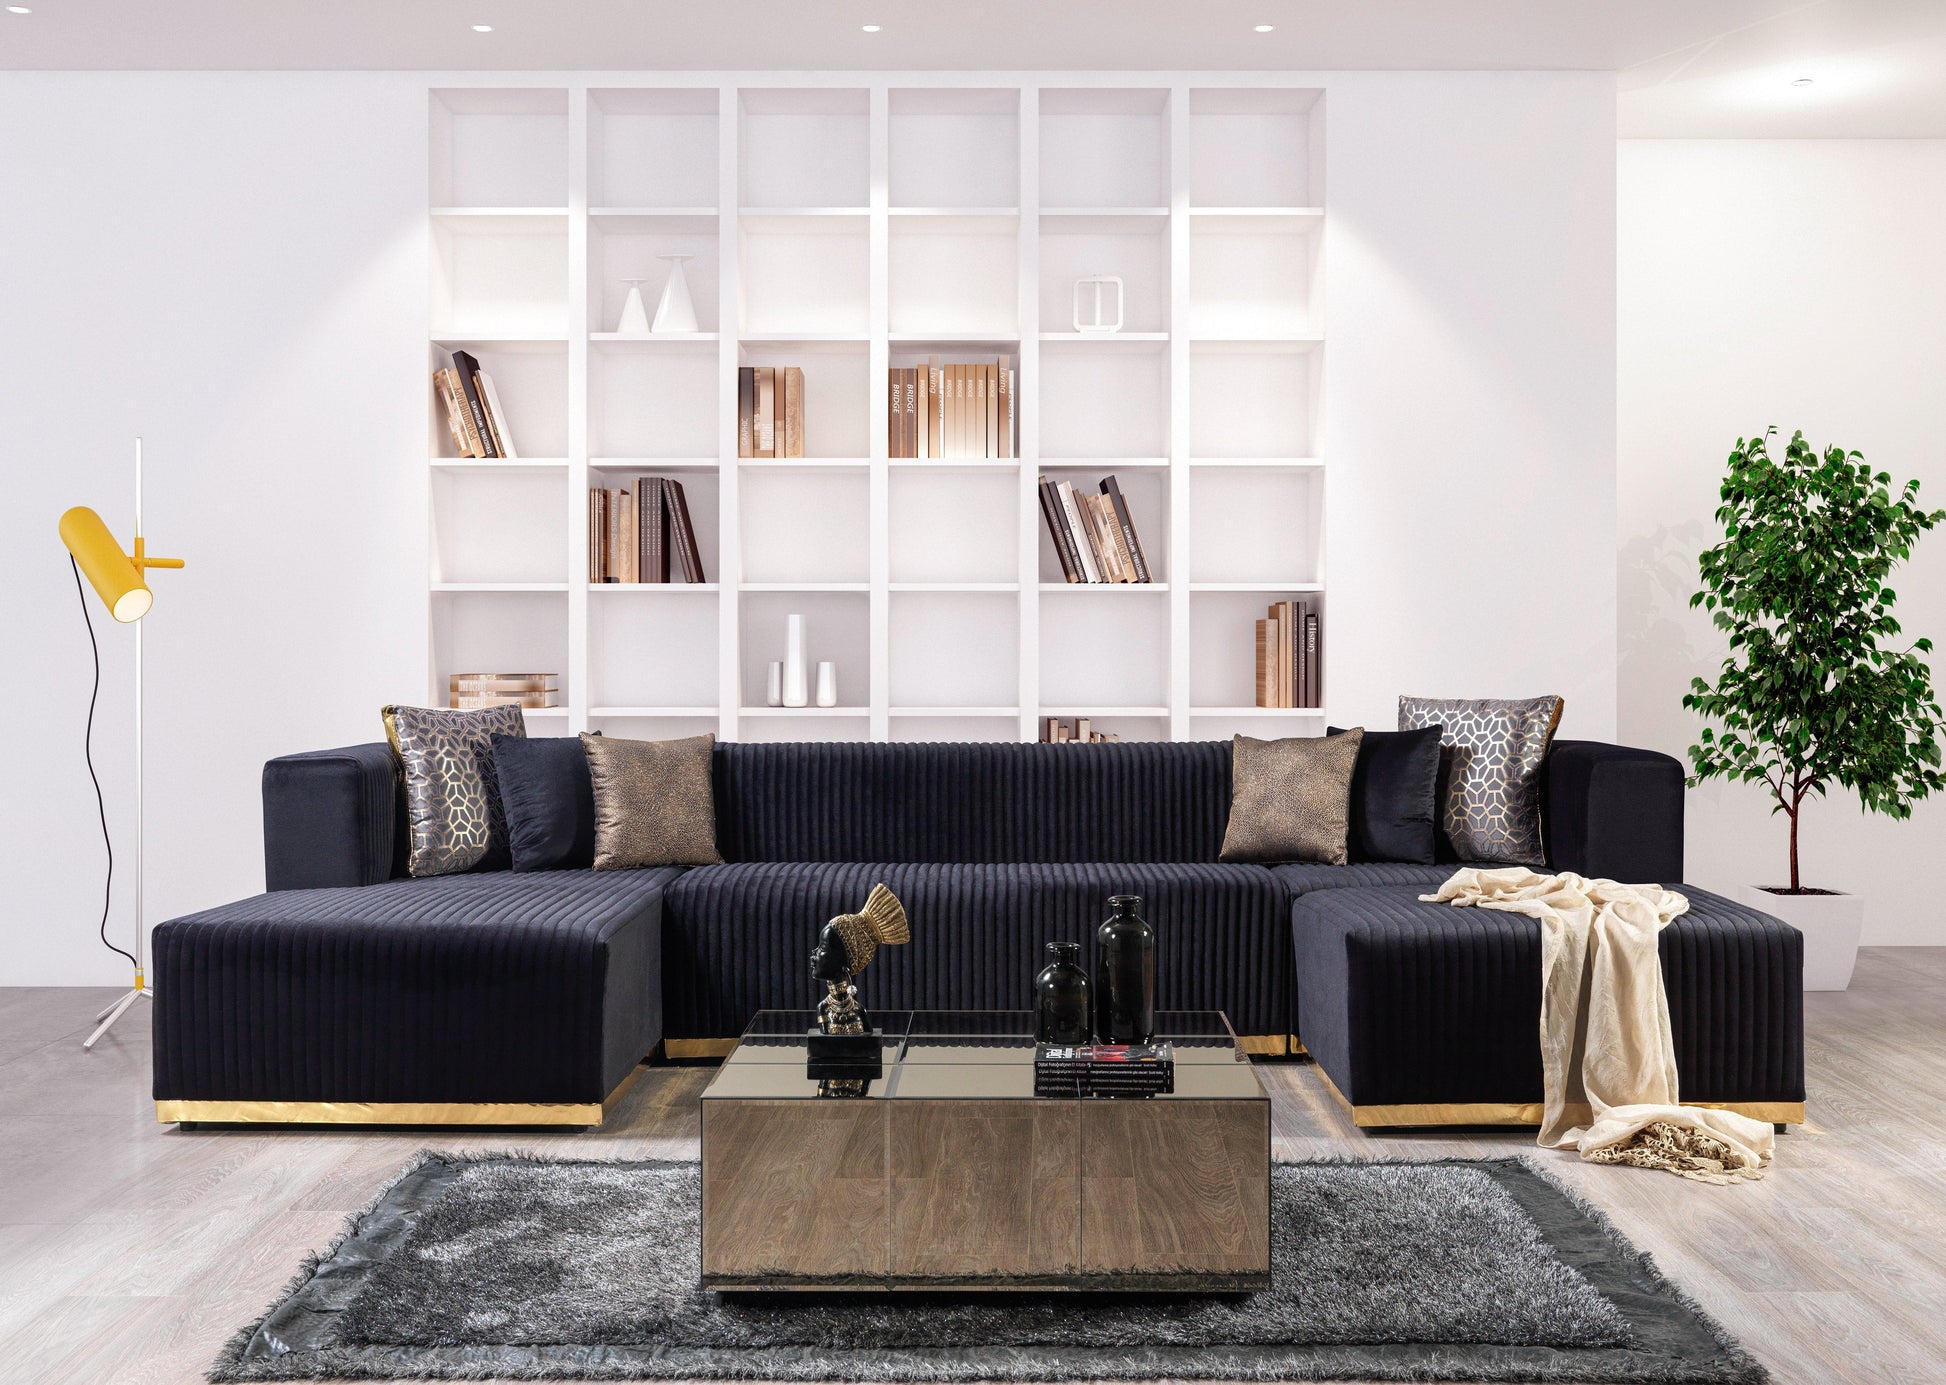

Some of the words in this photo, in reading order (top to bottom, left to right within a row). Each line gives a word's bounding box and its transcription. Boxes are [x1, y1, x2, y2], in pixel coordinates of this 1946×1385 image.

[929, 367, 939, 394] Living
[999, 367, 1008, 394] Living
[454, 387, 478, 440] PSYCHOTHERAPY
[741, 418, 749, 445] GRAPHIC
[1106, 511, 1129, 565] PSYCHOTHERAPY
[1307, 622, 1317, 653] History
